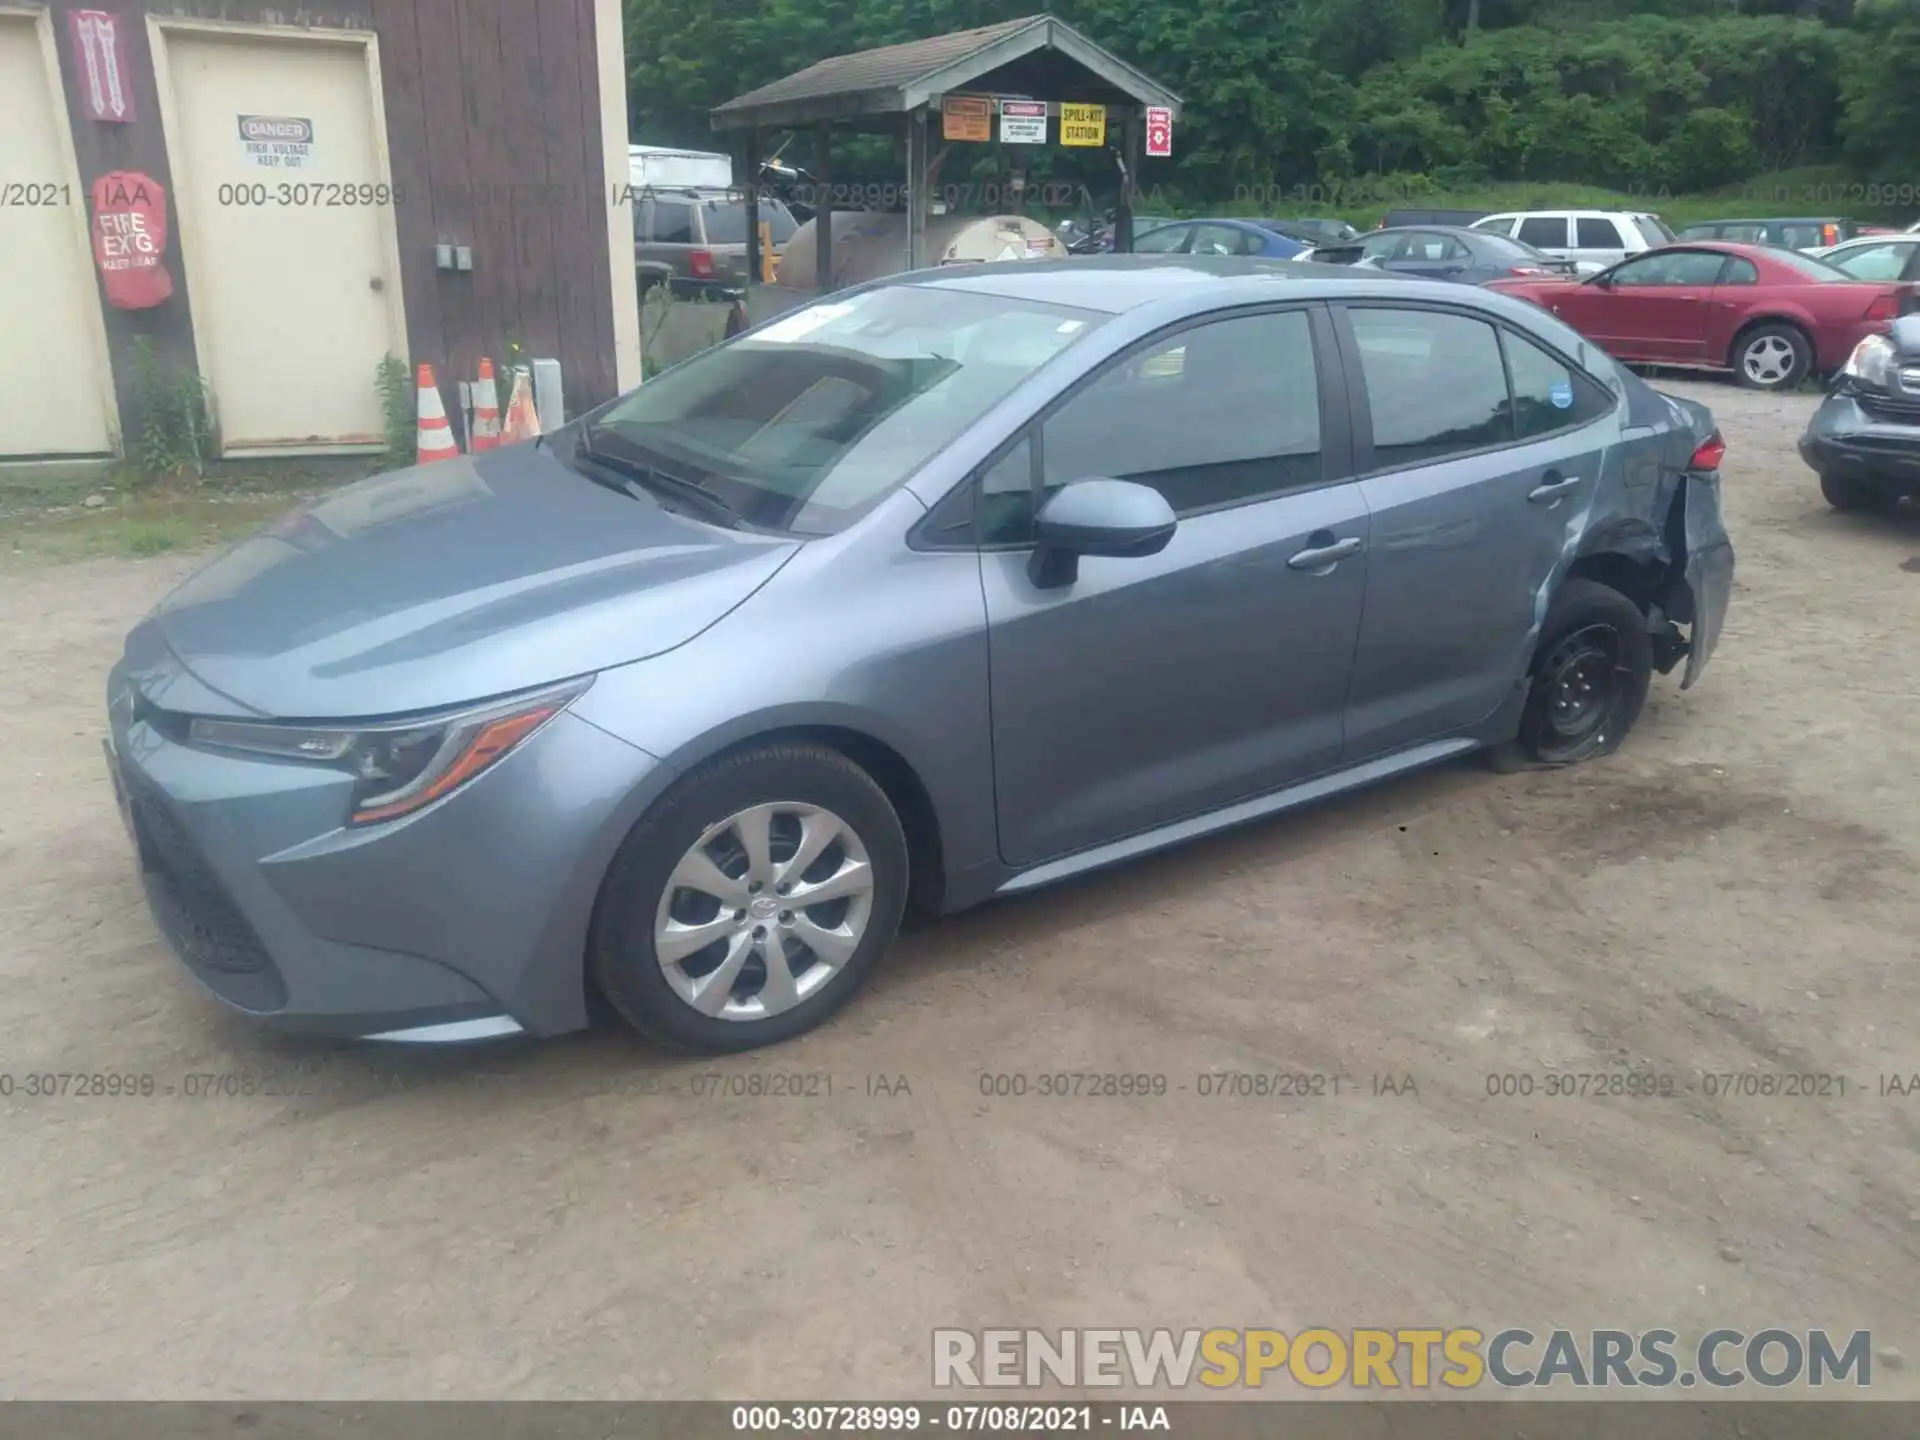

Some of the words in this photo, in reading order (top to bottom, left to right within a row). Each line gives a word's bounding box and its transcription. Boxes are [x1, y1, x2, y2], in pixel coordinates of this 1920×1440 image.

[248, 122, 303, 137] DANGER
[1065, 126, 1099, 139] STATION
[272, 143, 309, 155] VOLTAGE
[257, 154, 279, 166] KEEP
[100, 212, 145, 236] FIRE
